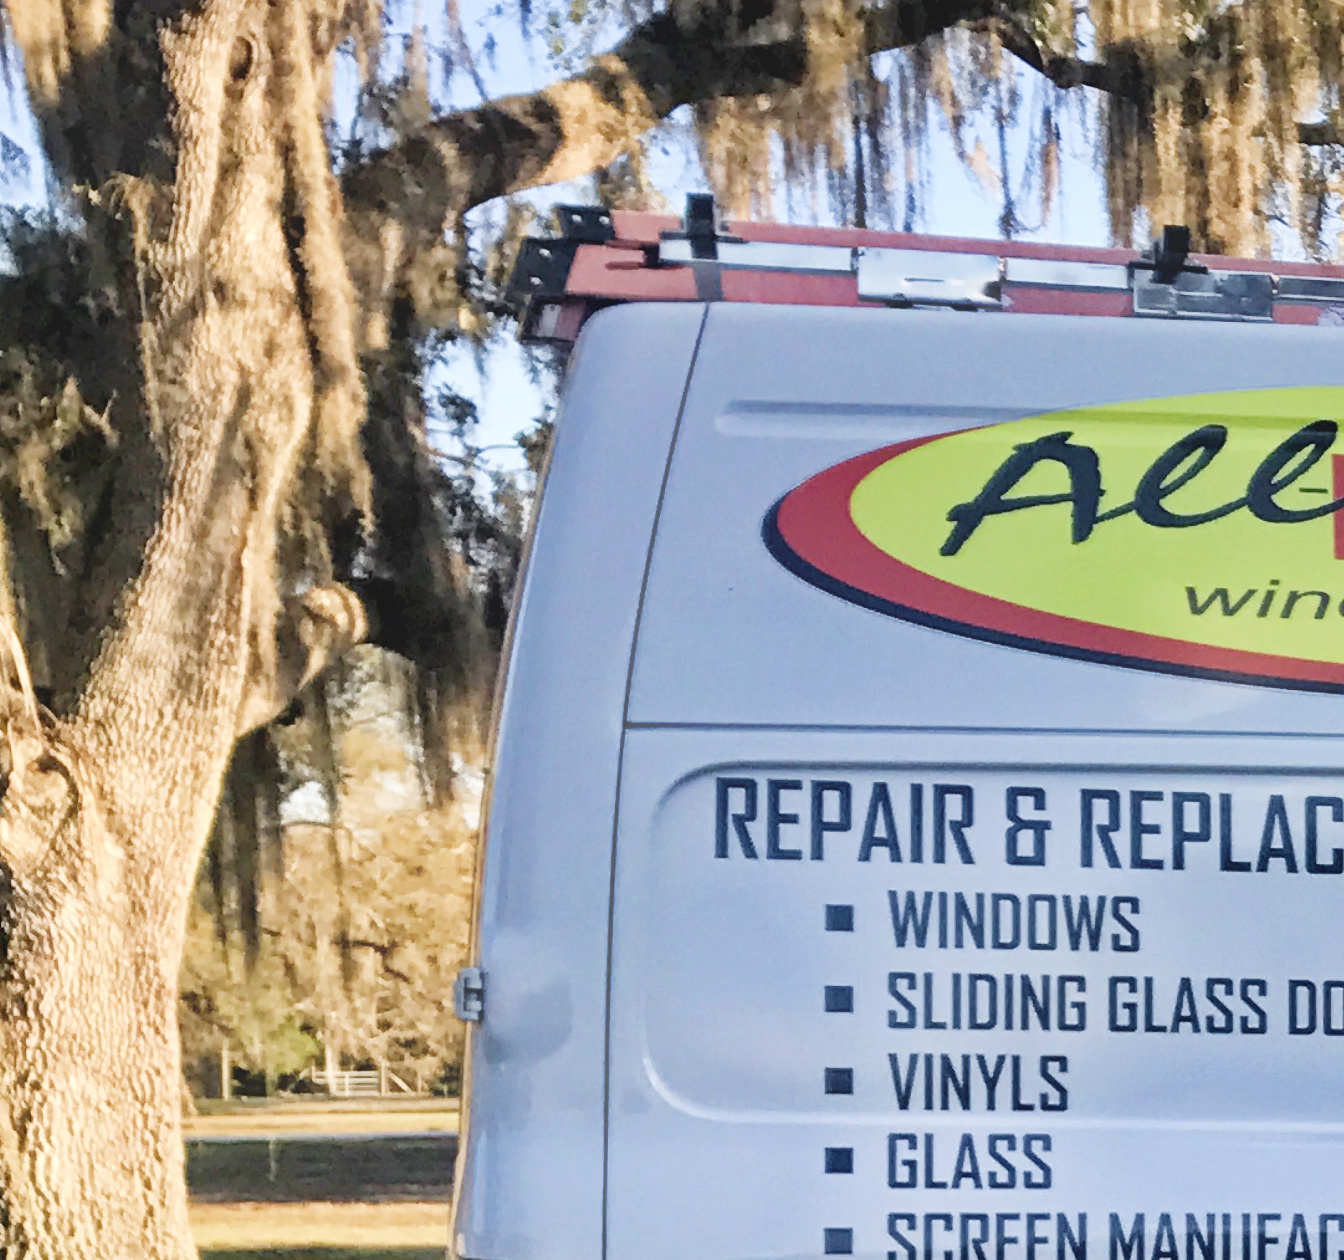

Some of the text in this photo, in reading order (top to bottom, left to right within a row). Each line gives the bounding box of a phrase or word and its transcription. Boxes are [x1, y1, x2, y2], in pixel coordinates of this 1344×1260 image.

[714, 777, 976, 865] REPAIR
[1005, 786, 1052, 866] &
[887, 890, 1141, 953] WINDOWS
[886, 972, 1087, 1032] SLIDING
[1107, 977, 1268, 1036] GLASS
[887, 1053, 1069, 1113] VINYLS
[886, 1133, 1053, 1190] GLASS
